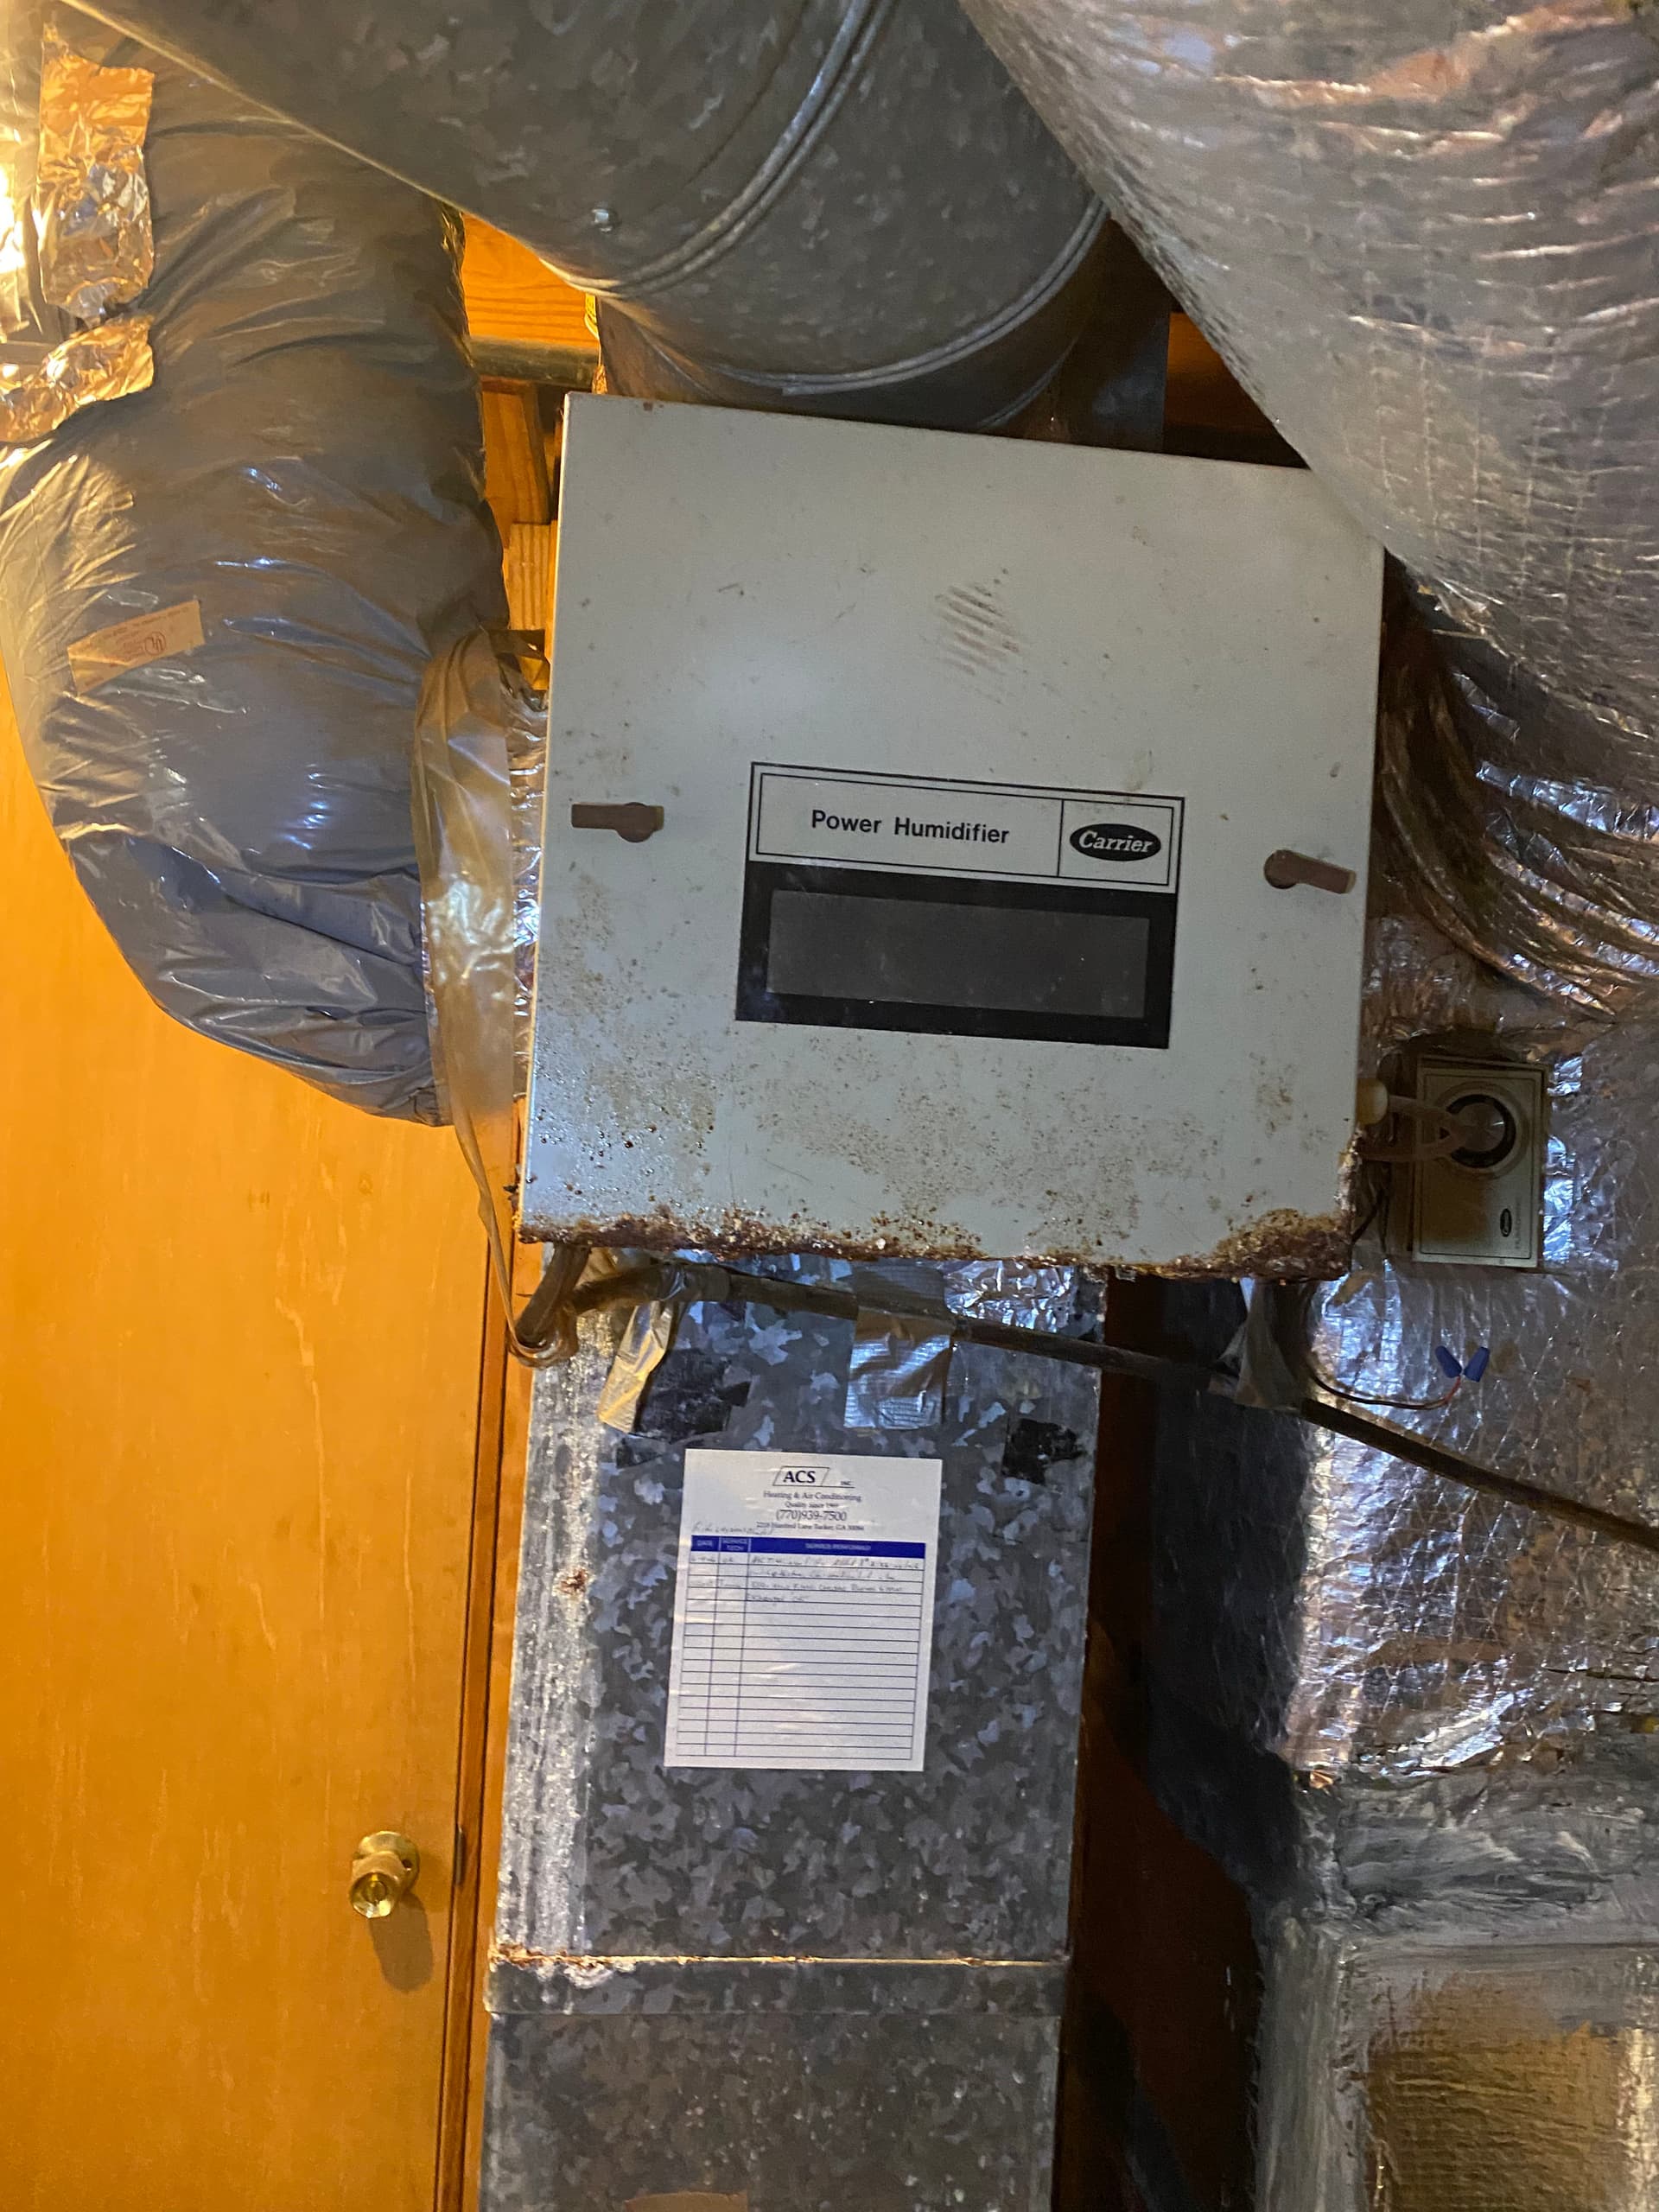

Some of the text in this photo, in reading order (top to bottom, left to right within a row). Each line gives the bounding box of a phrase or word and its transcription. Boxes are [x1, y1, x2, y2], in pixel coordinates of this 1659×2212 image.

[811, 810, 1010, 844] Power Humidifier
[1077, 830, 1155, 855] Carrier
[783, 1470, 816, 1484] ACS
[763, 1491, 792, 1500] Heating
[814, 1491, 862, 1503] Conditioning
[776, 1509, 848, 1522] (770)939-7500
